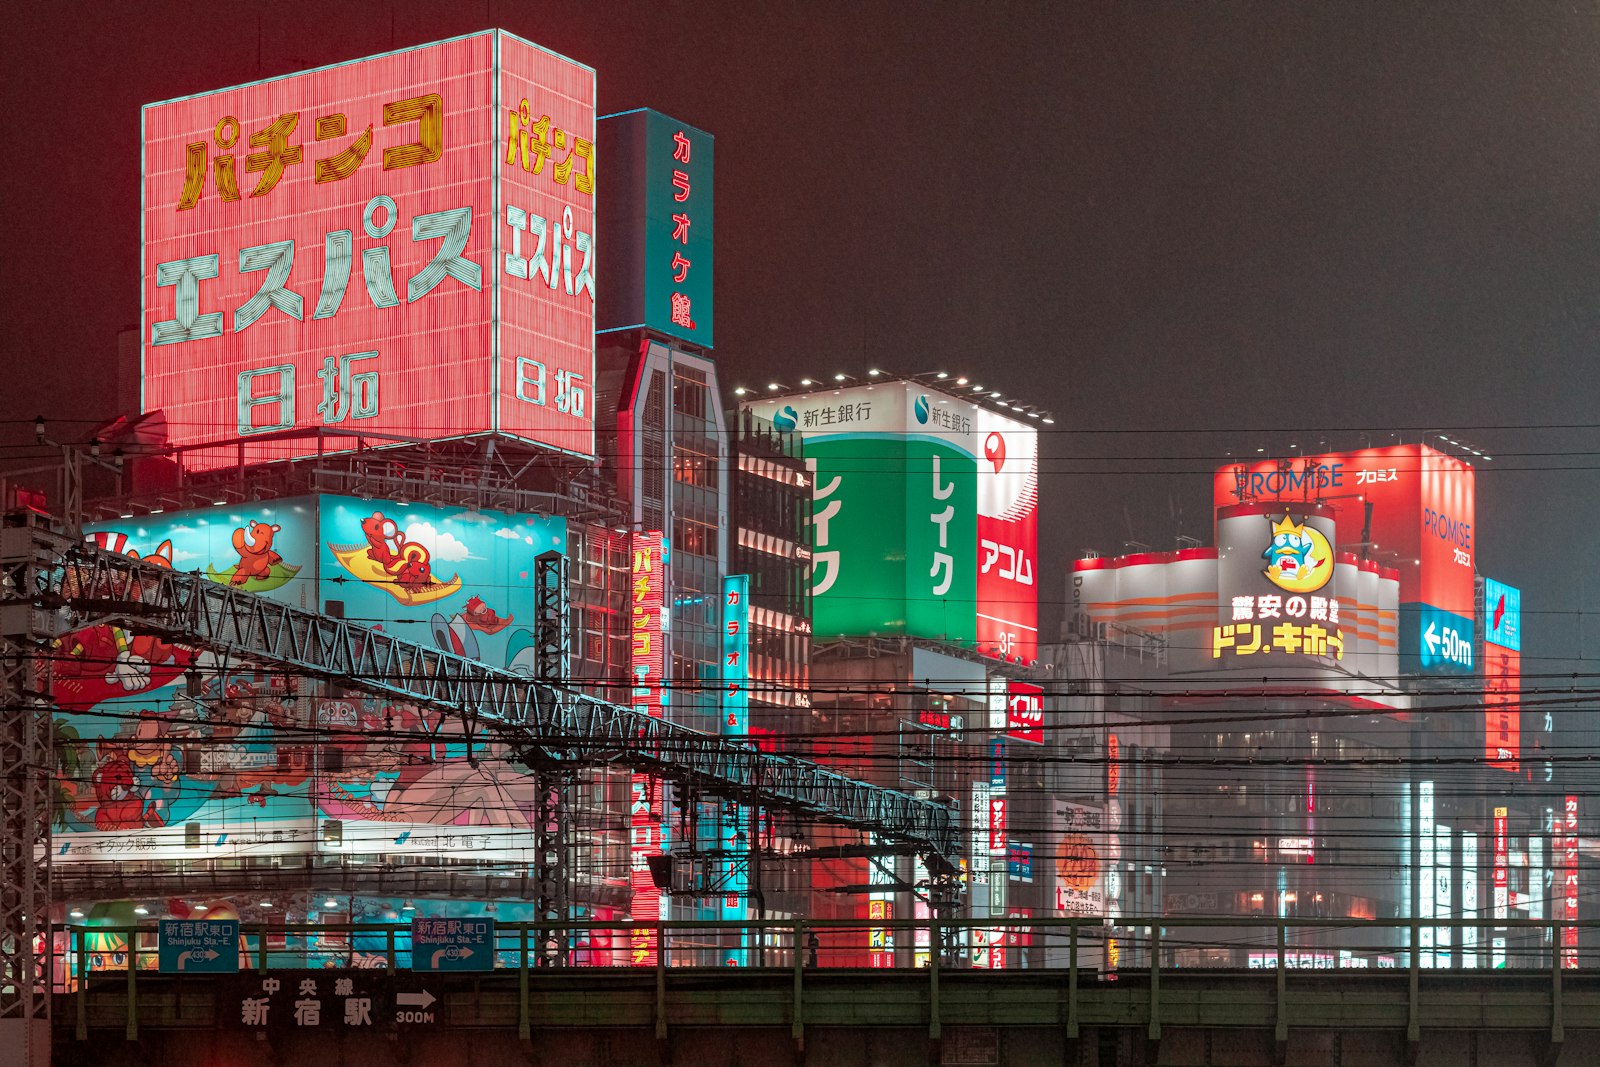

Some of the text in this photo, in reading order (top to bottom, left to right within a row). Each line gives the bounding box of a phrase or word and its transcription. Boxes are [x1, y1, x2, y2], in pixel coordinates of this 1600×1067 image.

[176, 93, 441, 212] パチンコ
[506, 98, 594, 195] パチンコ
[671, 131, 691, 328] カラオケ館
[506, 205, 595, 303] エスパス
[152, 195, 482, 346] エスパス
[238, 350, 380, 436] 日拓
[516, 356, 584, 418] 日拓
[803, 402, 872, 428] 新生銀行
[931, 407, 971, 436] 新生銀行
[1356, 468, 1398, 484] プロミス
[930, 455, 955, 596] レイク
[1424, 508, 1471, 549] PROMISE
[981, 538, 1033, 586] アコム
[633, 547, 652, 656] パチンコ
[1231, 594, 1339, 624] 驚安の殿堂
[998, 632, 1016, 654] 3F
[1441, 628, 1471, 667] 50m
[1009, 695, 1042, 722] イフル
[165, 922, 233, 936] 新宿駅東口
[167, 937, 201, 946] Shinjuku
[418, 920, 487, 935] 新宿駅東口
[420, 935, 454, 945] Shinjuku
[262, 977, 353, 996] 中央線
[241, 997, 372, 1026] 新宿駅
[395, 1011, 435, 1024] 300M
